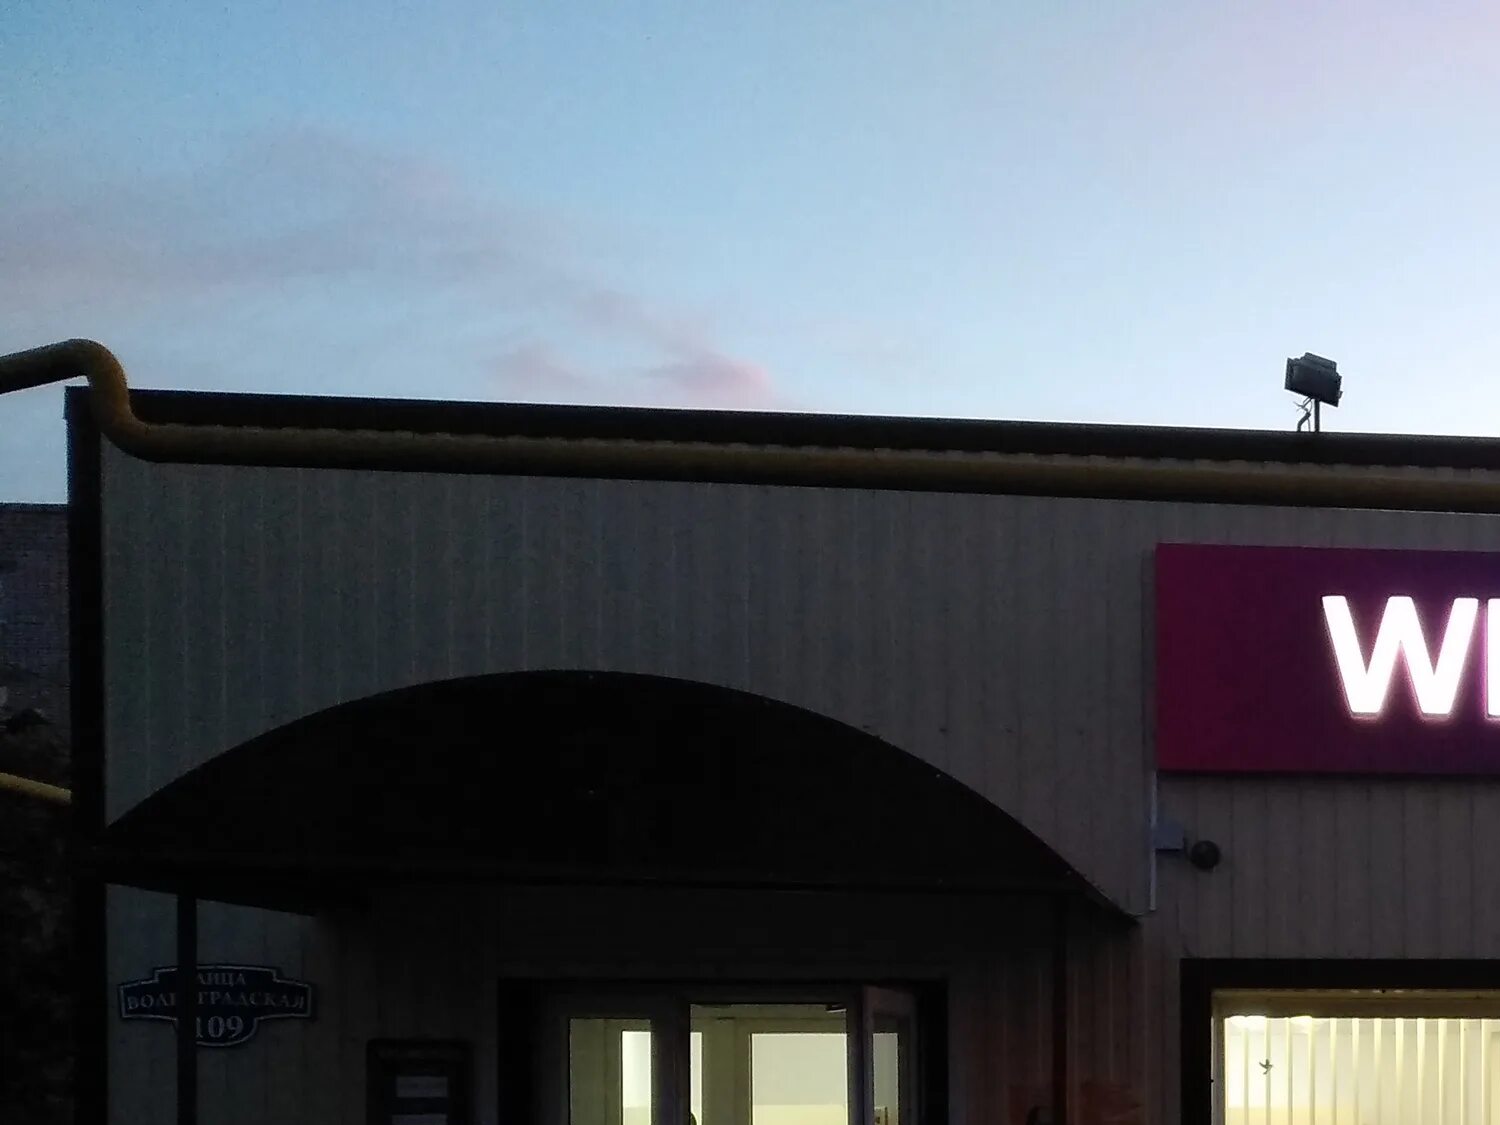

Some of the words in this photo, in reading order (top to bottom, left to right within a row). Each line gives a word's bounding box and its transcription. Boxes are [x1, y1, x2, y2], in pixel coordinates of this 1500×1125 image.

[190, 972, 247, 988] ЛИЦА
[127, 991, 305, 1010] ВОЛГГРАДСКАЯ
[194, 1015, 244, 1038] 109
